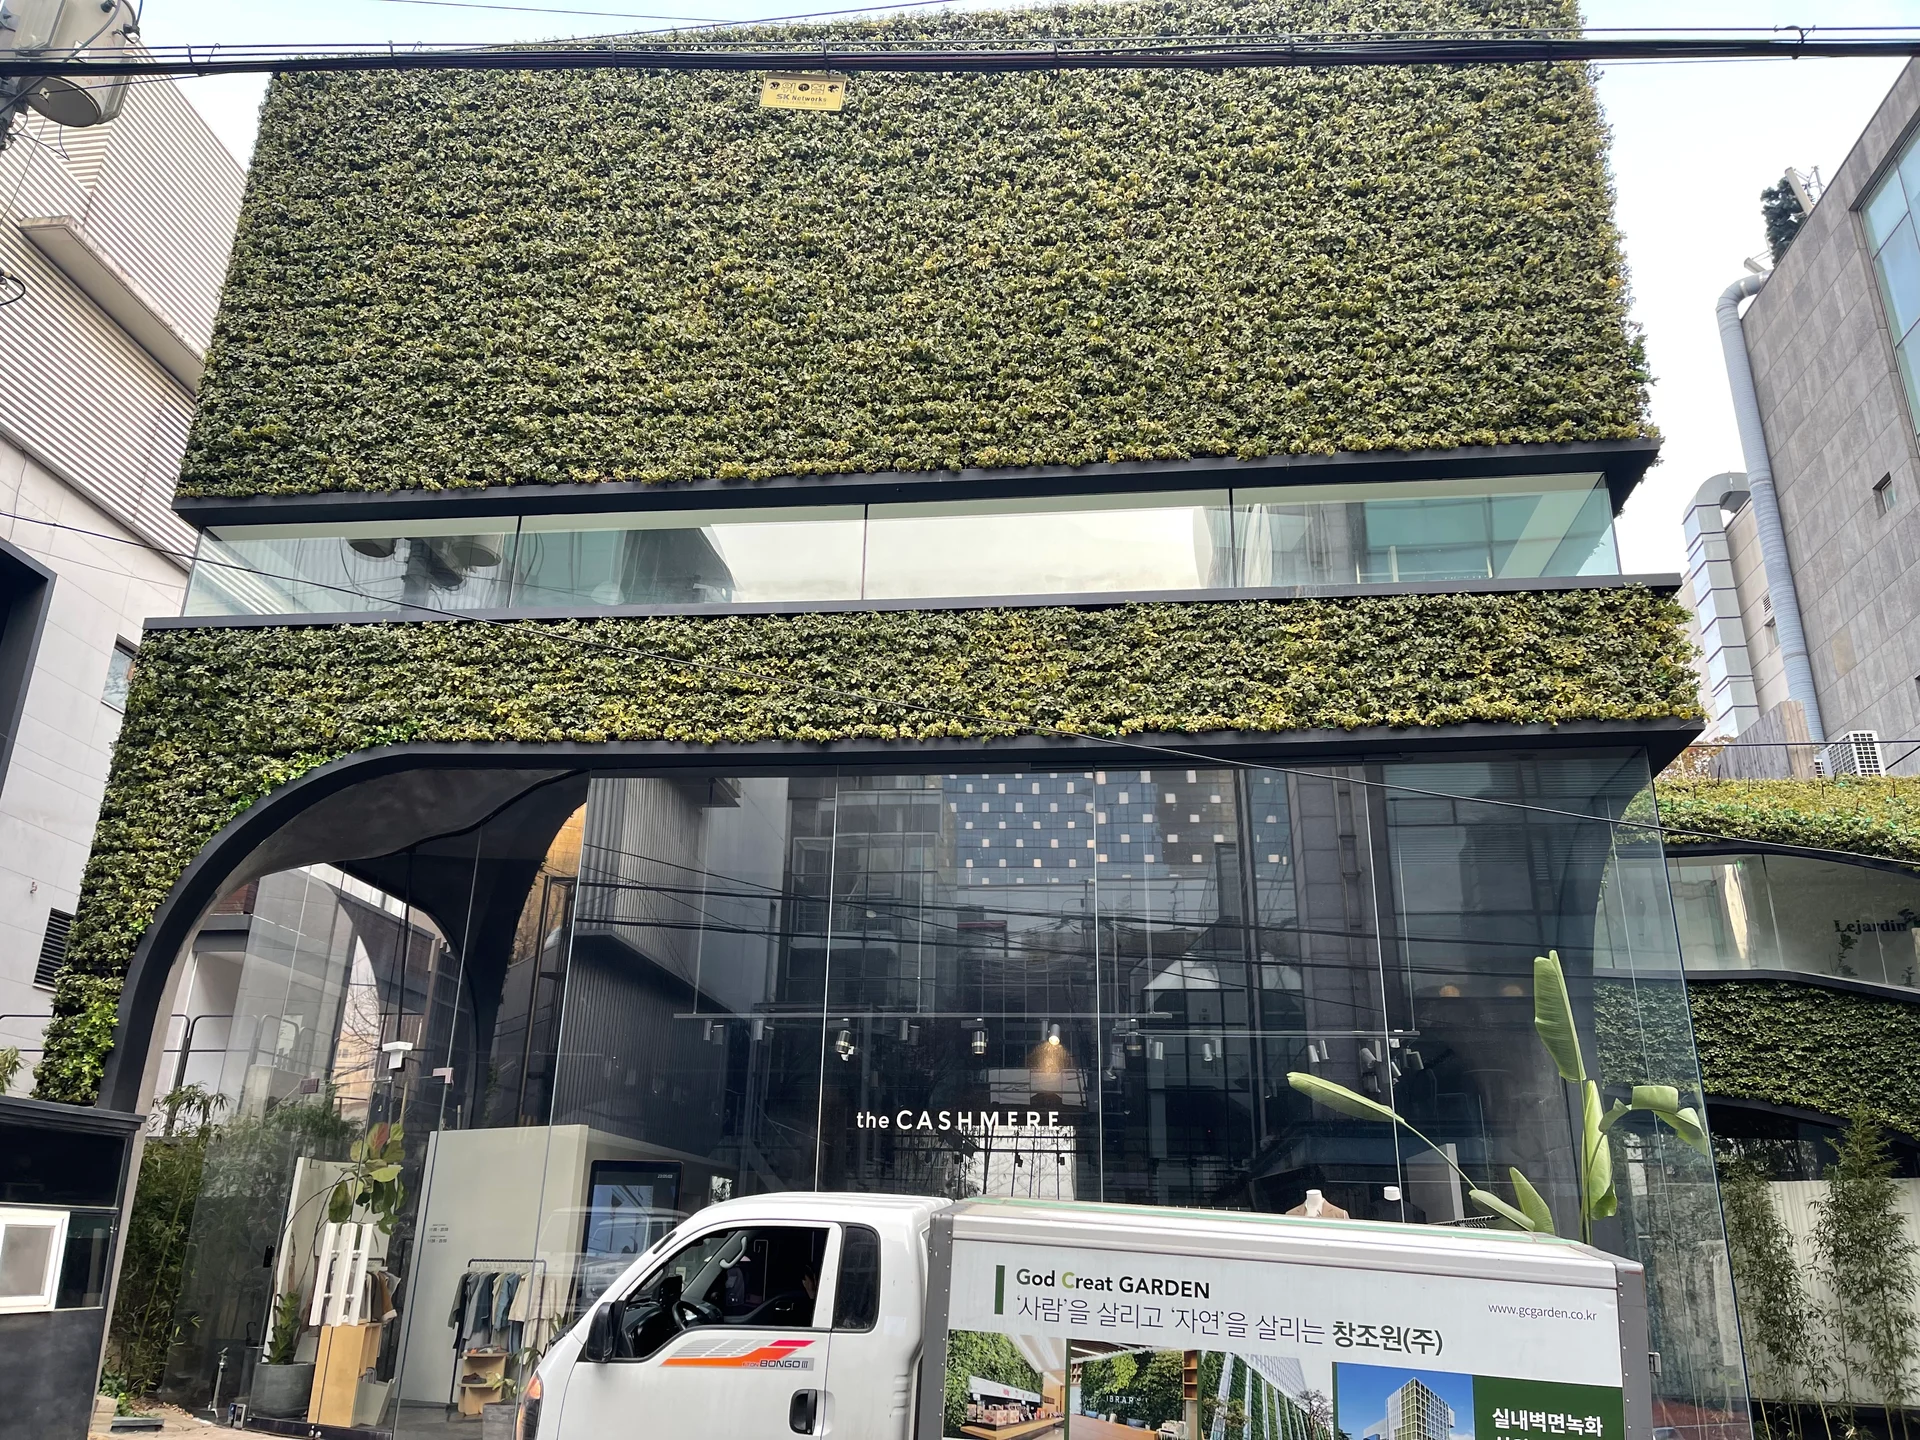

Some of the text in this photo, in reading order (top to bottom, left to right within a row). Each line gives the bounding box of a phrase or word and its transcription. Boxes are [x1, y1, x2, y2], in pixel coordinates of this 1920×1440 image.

[1833, 920, 1907, 935] Lejardin
[856, 1109, 1060, 1131] the CASHMERE
[1016, 1268, 1210, 1299] God Creat GARDEN
[1487, 1304, 1598, 1321] www.gcgarden.co.kr
[1096, 1302, 1164, 1329] 살리고
[1255, 1315, 1326, 1345] 살리는
[1332, 1320, 1443, 1356] 창조원(주)
[760, 1359, 800, 1368] BONGO
[1491, 1408, 1604, 1437] 실내벽면녹화
